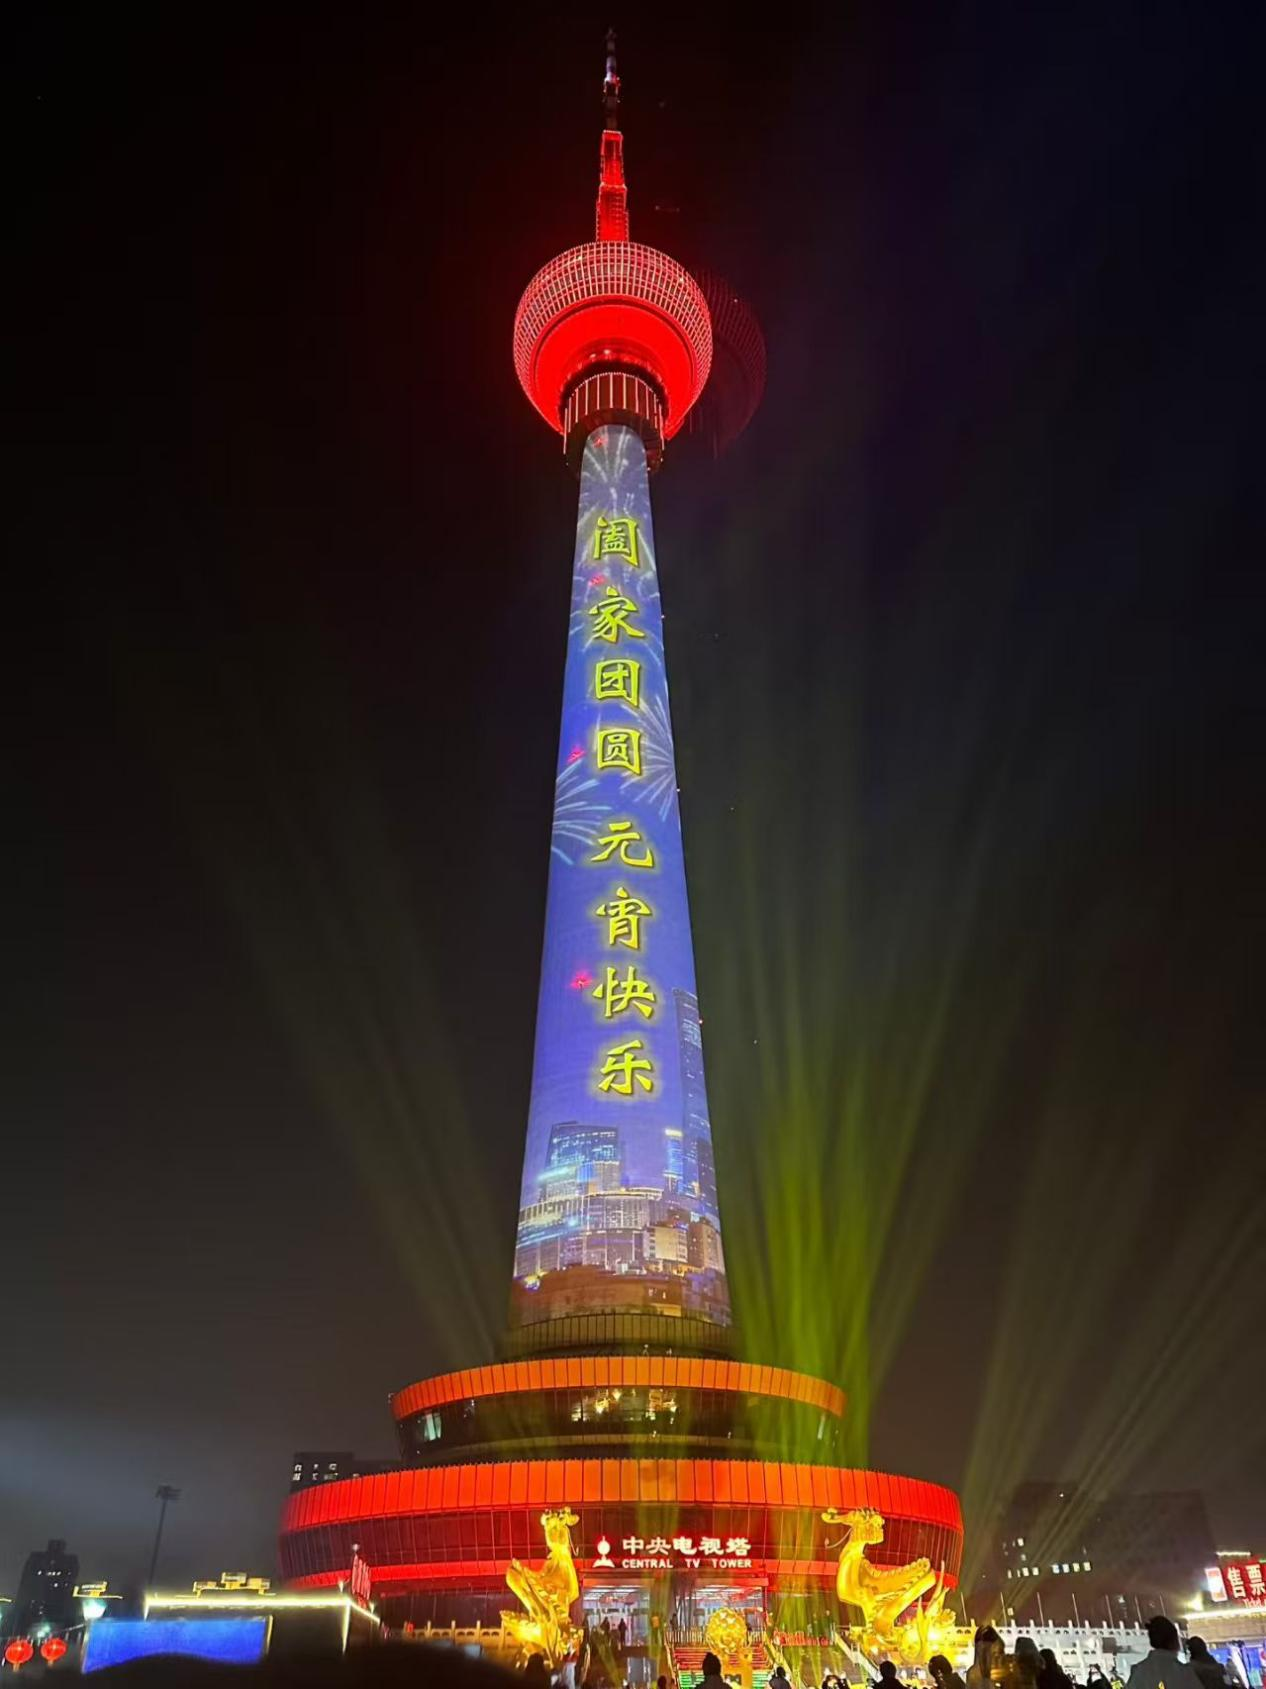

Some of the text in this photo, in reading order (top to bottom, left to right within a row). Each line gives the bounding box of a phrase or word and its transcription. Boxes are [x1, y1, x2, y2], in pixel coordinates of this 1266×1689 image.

[588, 516, 655, 1094] 阖家团圆 元宵快乐
[622, 1536, 752, 1556] 中央电视塔
[622, 1558, 752, 1569] CENTRAL TV TOWER
[1227, 1564, 1266, 1598] 售票
